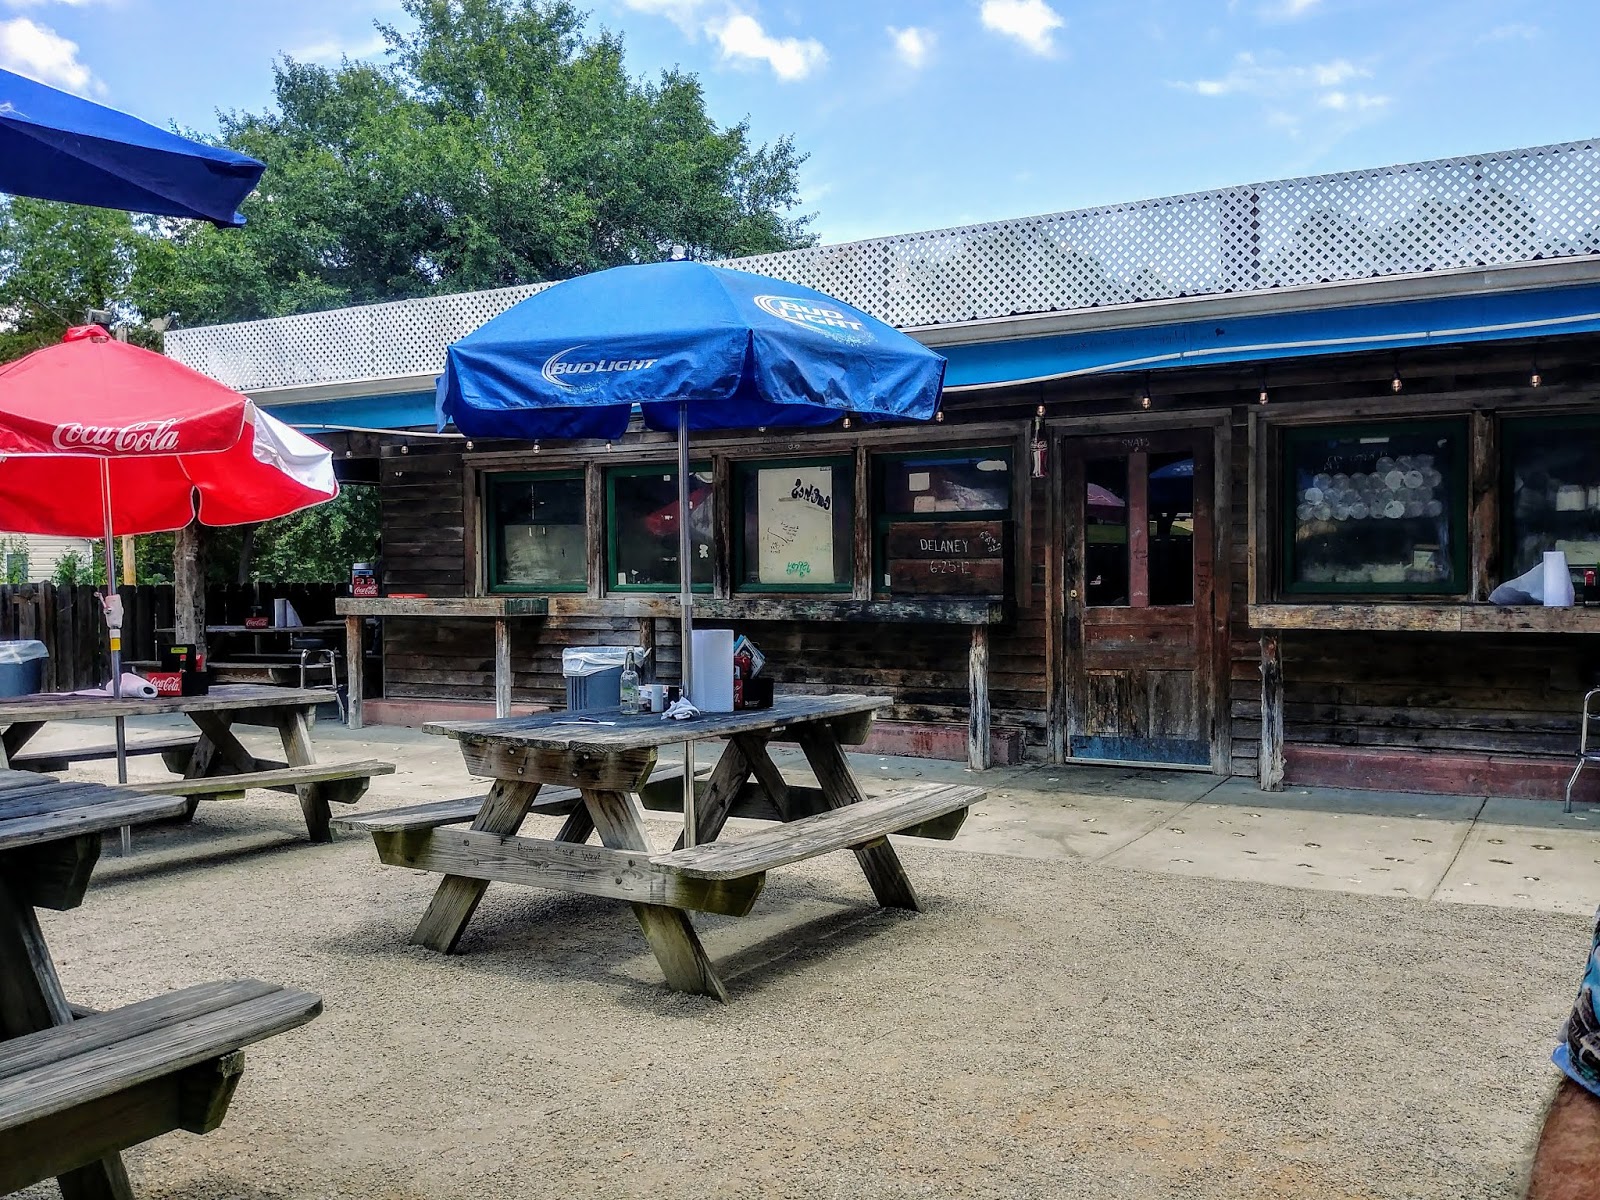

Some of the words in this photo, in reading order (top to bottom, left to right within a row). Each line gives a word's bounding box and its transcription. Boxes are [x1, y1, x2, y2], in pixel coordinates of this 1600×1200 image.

[779, 300, 844, 319] BUD
[779, 308, 863, 331] LIGHT
[550, 362, 596, 375] BUD
[596, 358, 659, 372] LIGHT
[920, 538, 970, 553] DELANEY
[929, 560, 971, 574] 6-25-12
